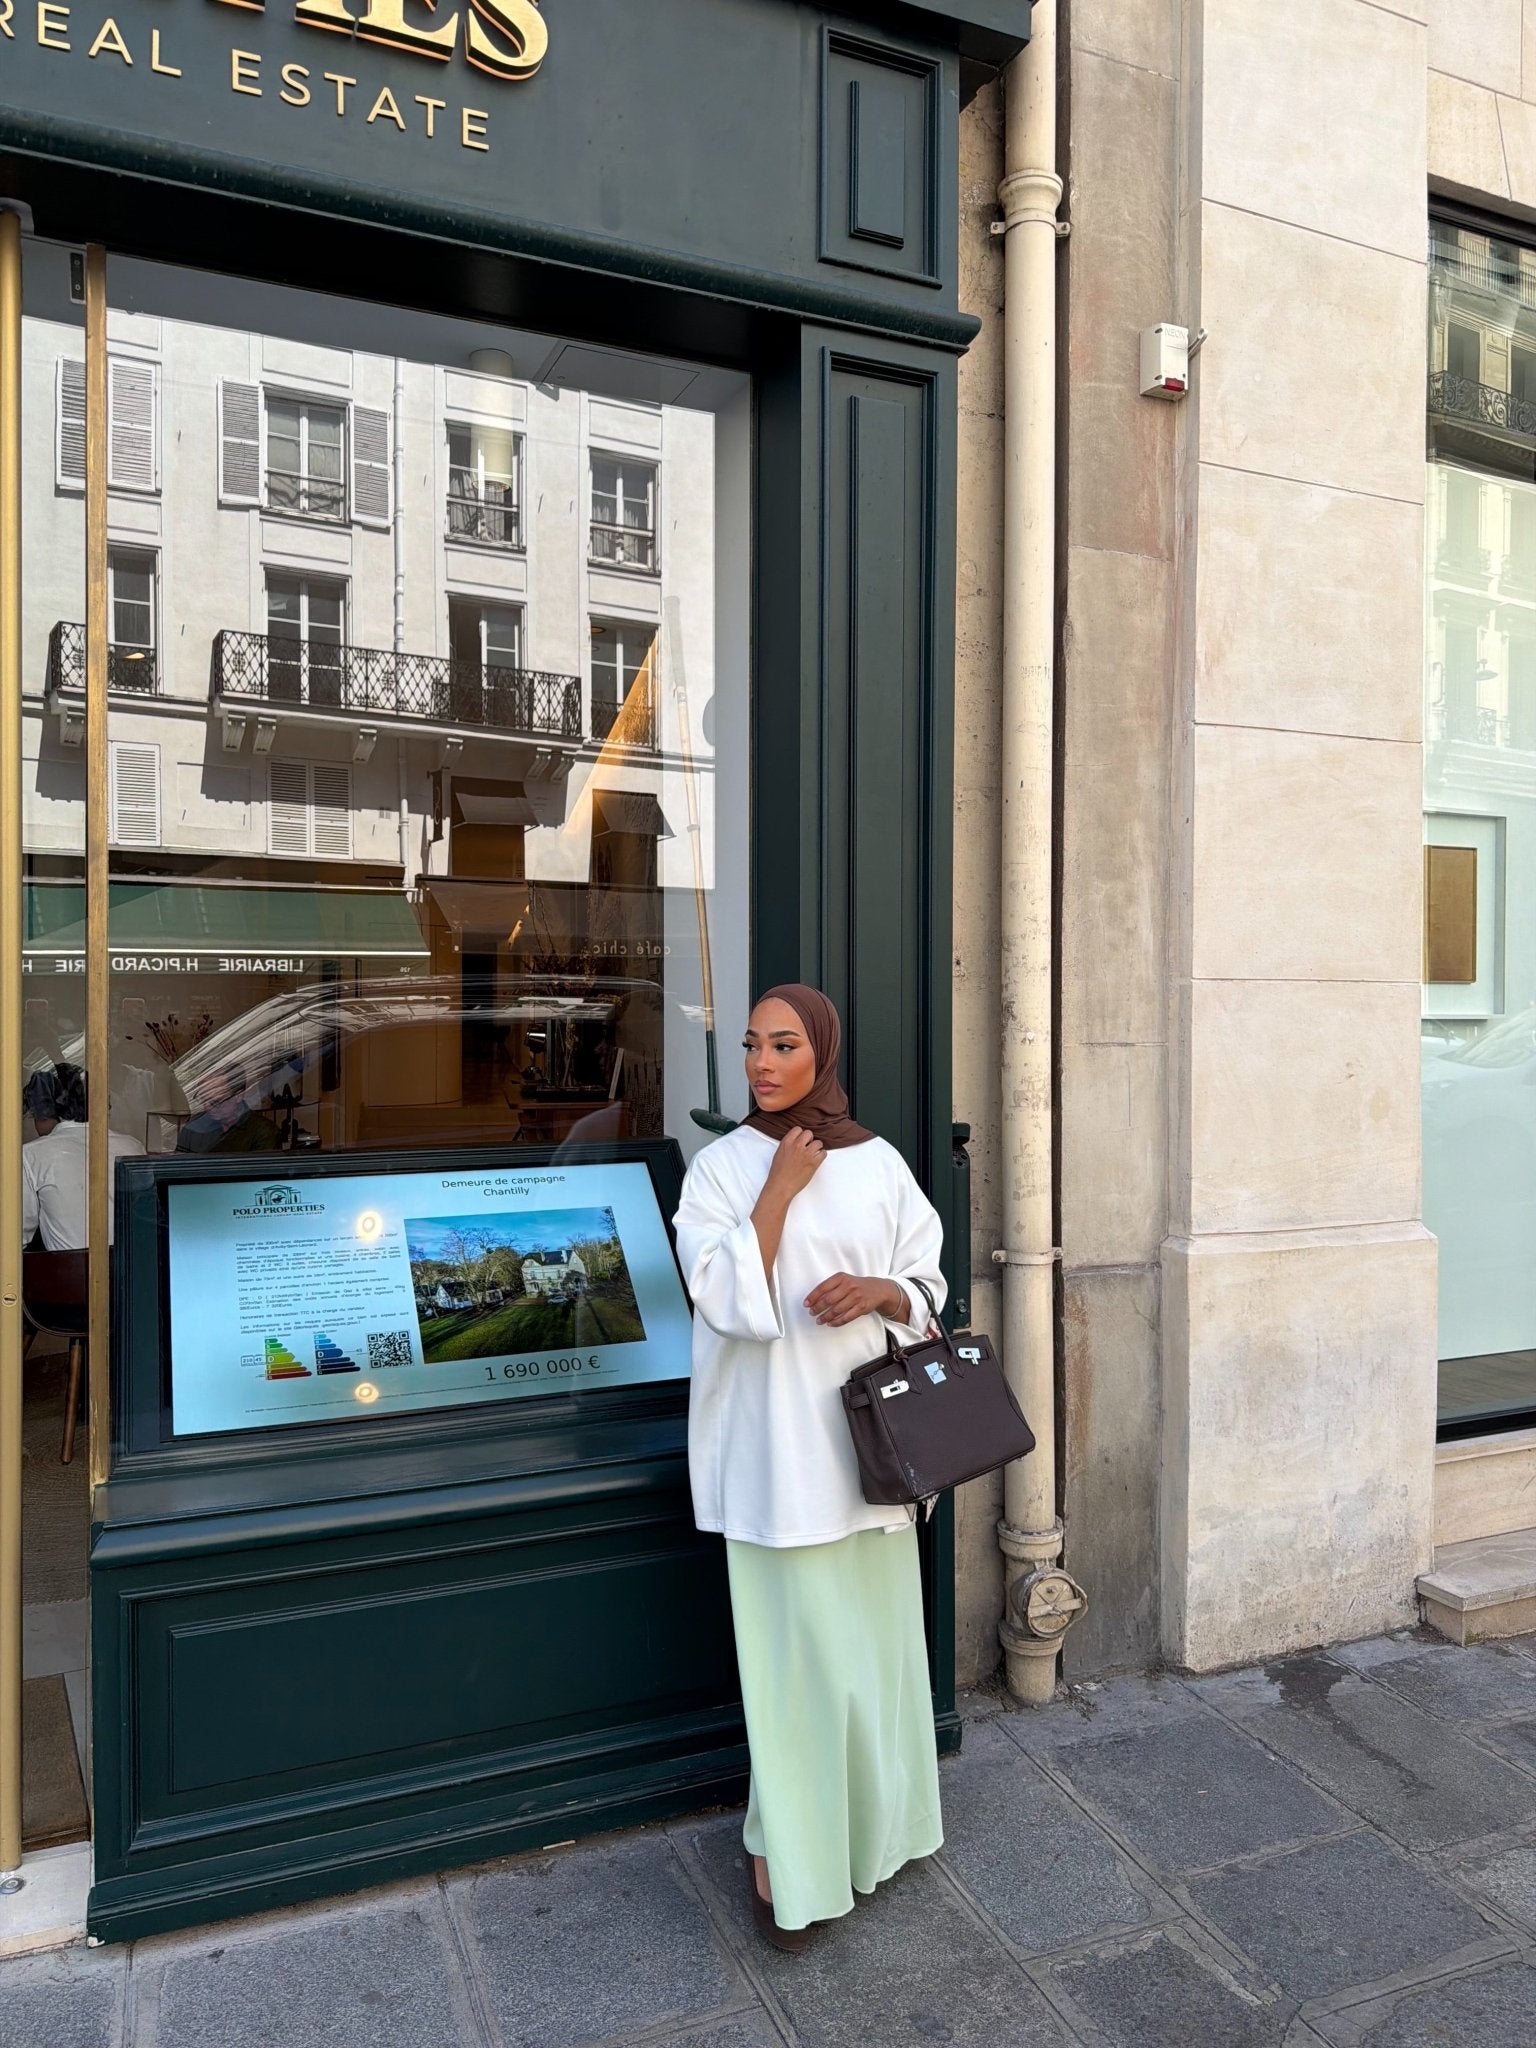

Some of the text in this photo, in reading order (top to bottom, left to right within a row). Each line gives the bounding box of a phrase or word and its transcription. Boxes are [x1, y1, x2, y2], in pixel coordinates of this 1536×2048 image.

[231, 48, 490, 151] ESTATE
[442, 1175, 566, 1188] Demeure de campagne
[483, 1187, 530, 1197] Chantilly
[233, 1203, 326, 1216] POLO PROPERTIES
[485, 1366, 496, 1381] 1
[503, 1361, 540, 1379] 690
[546, 1356, 583, 1374] 000
[588, 1355, 601, 1370] €
